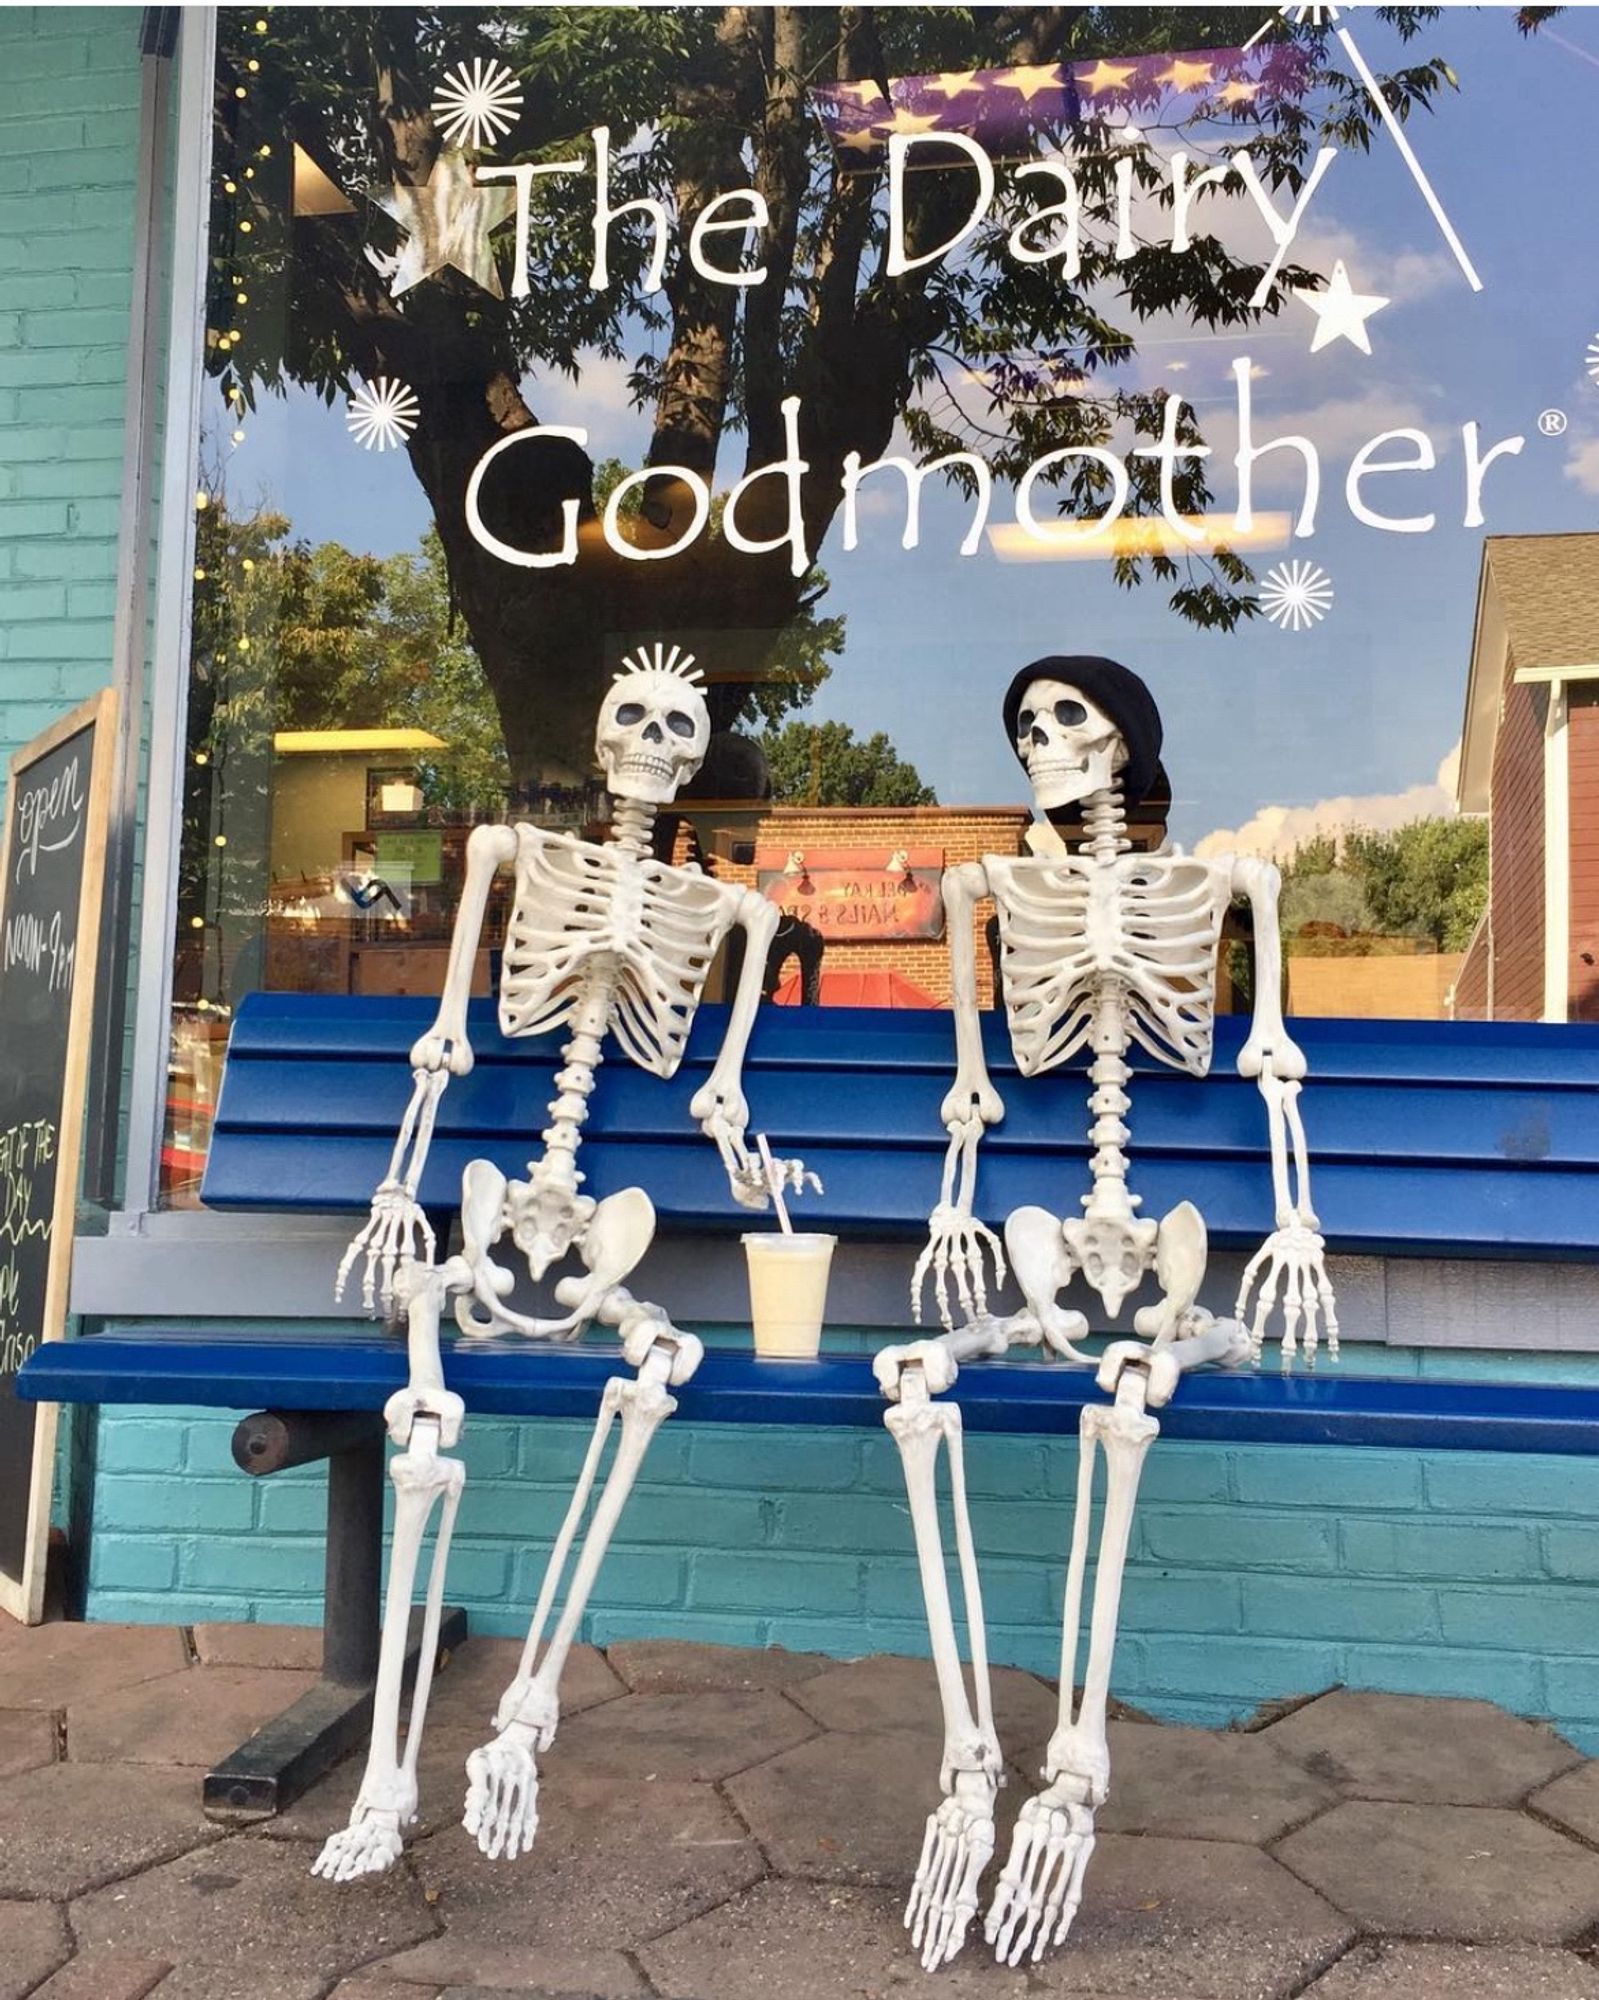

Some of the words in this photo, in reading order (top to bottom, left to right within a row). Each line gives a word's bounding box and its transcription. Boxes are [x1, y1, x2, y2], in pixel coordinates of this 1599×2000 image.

[476, 126, 769, 299] The
[885, 125, 1338, 308] Dairy
[17, 756, 84, 880] open
[33, 1118, 56, 1172] THE
[4, 1171, 33, 1219] DAY
